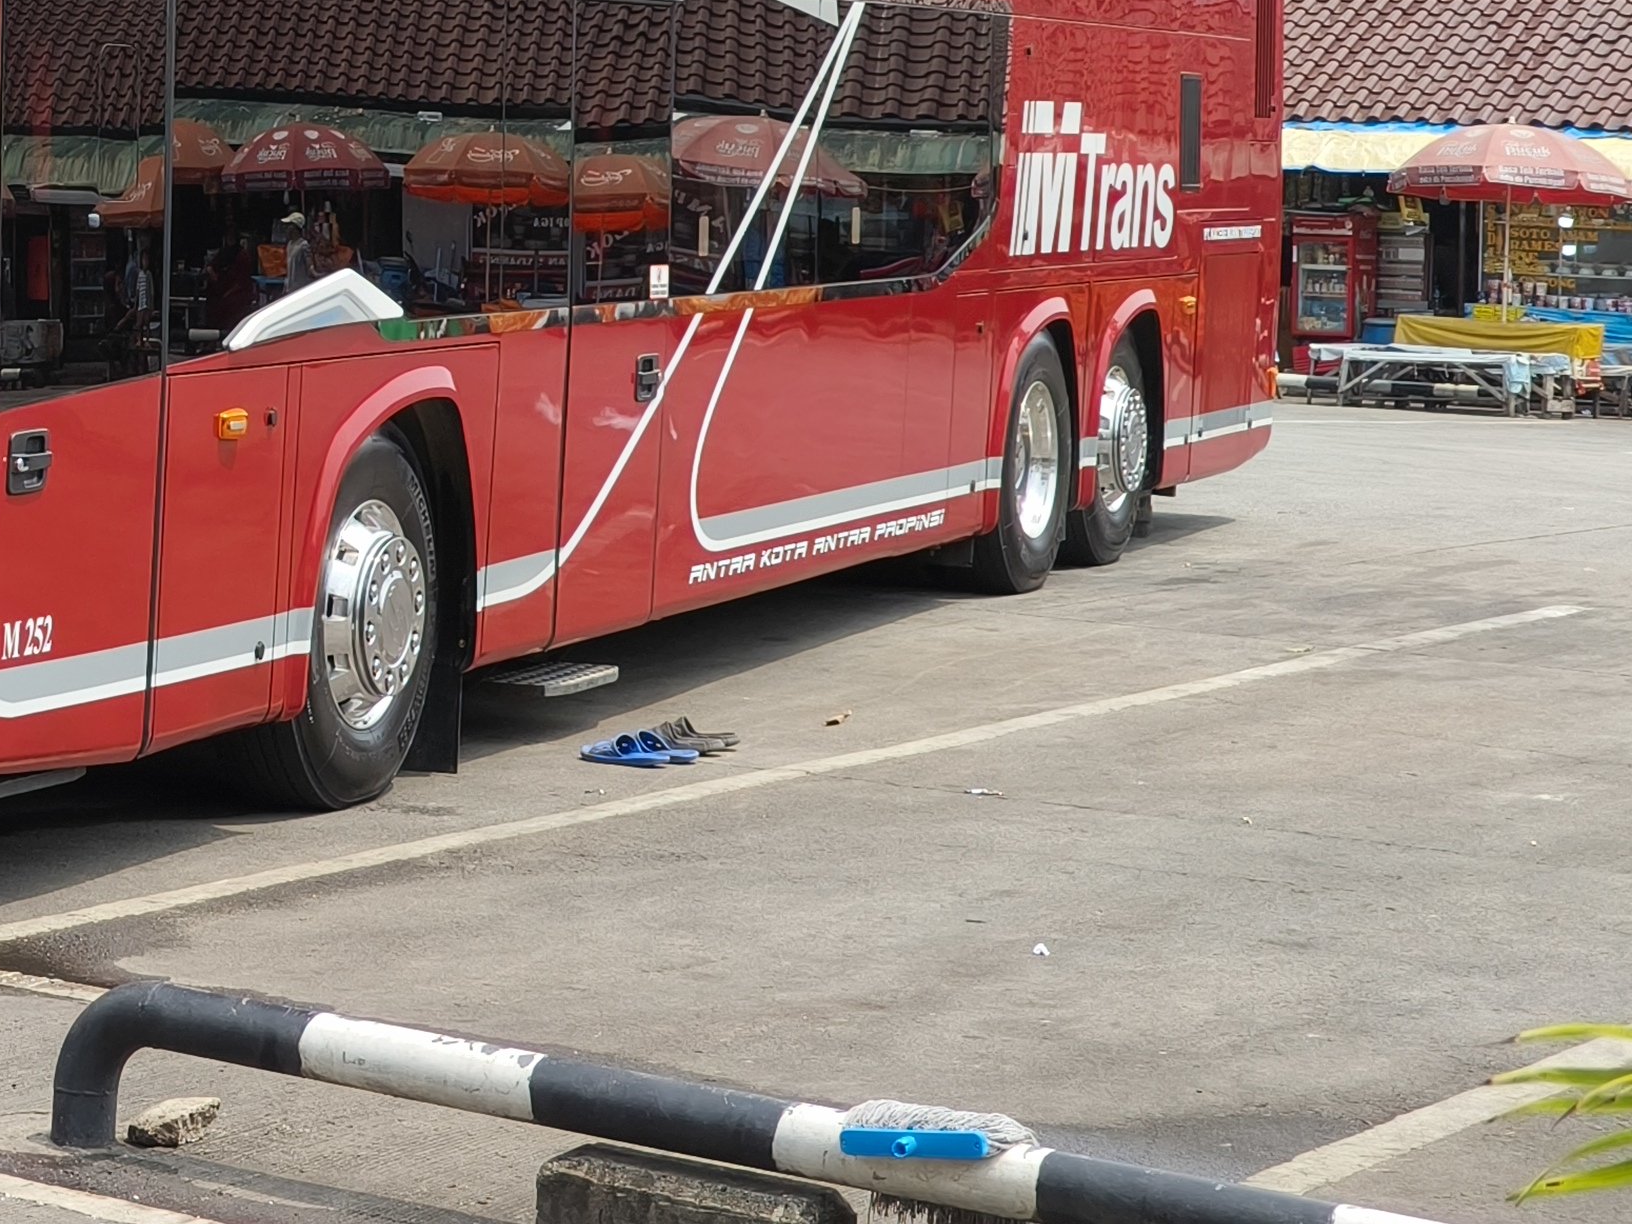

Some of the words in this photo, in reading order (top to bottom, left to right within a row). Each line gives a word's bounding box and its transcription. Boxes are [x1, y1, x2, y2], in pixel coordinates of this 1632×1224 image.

[688, 553, 756, 585] ANTAR
[758, 540, 808, 569] KOTA
[811, 526, 872, 556] ANTAR
[1, 620, 22, 661] M
[23, 614, 53, 656] 252
